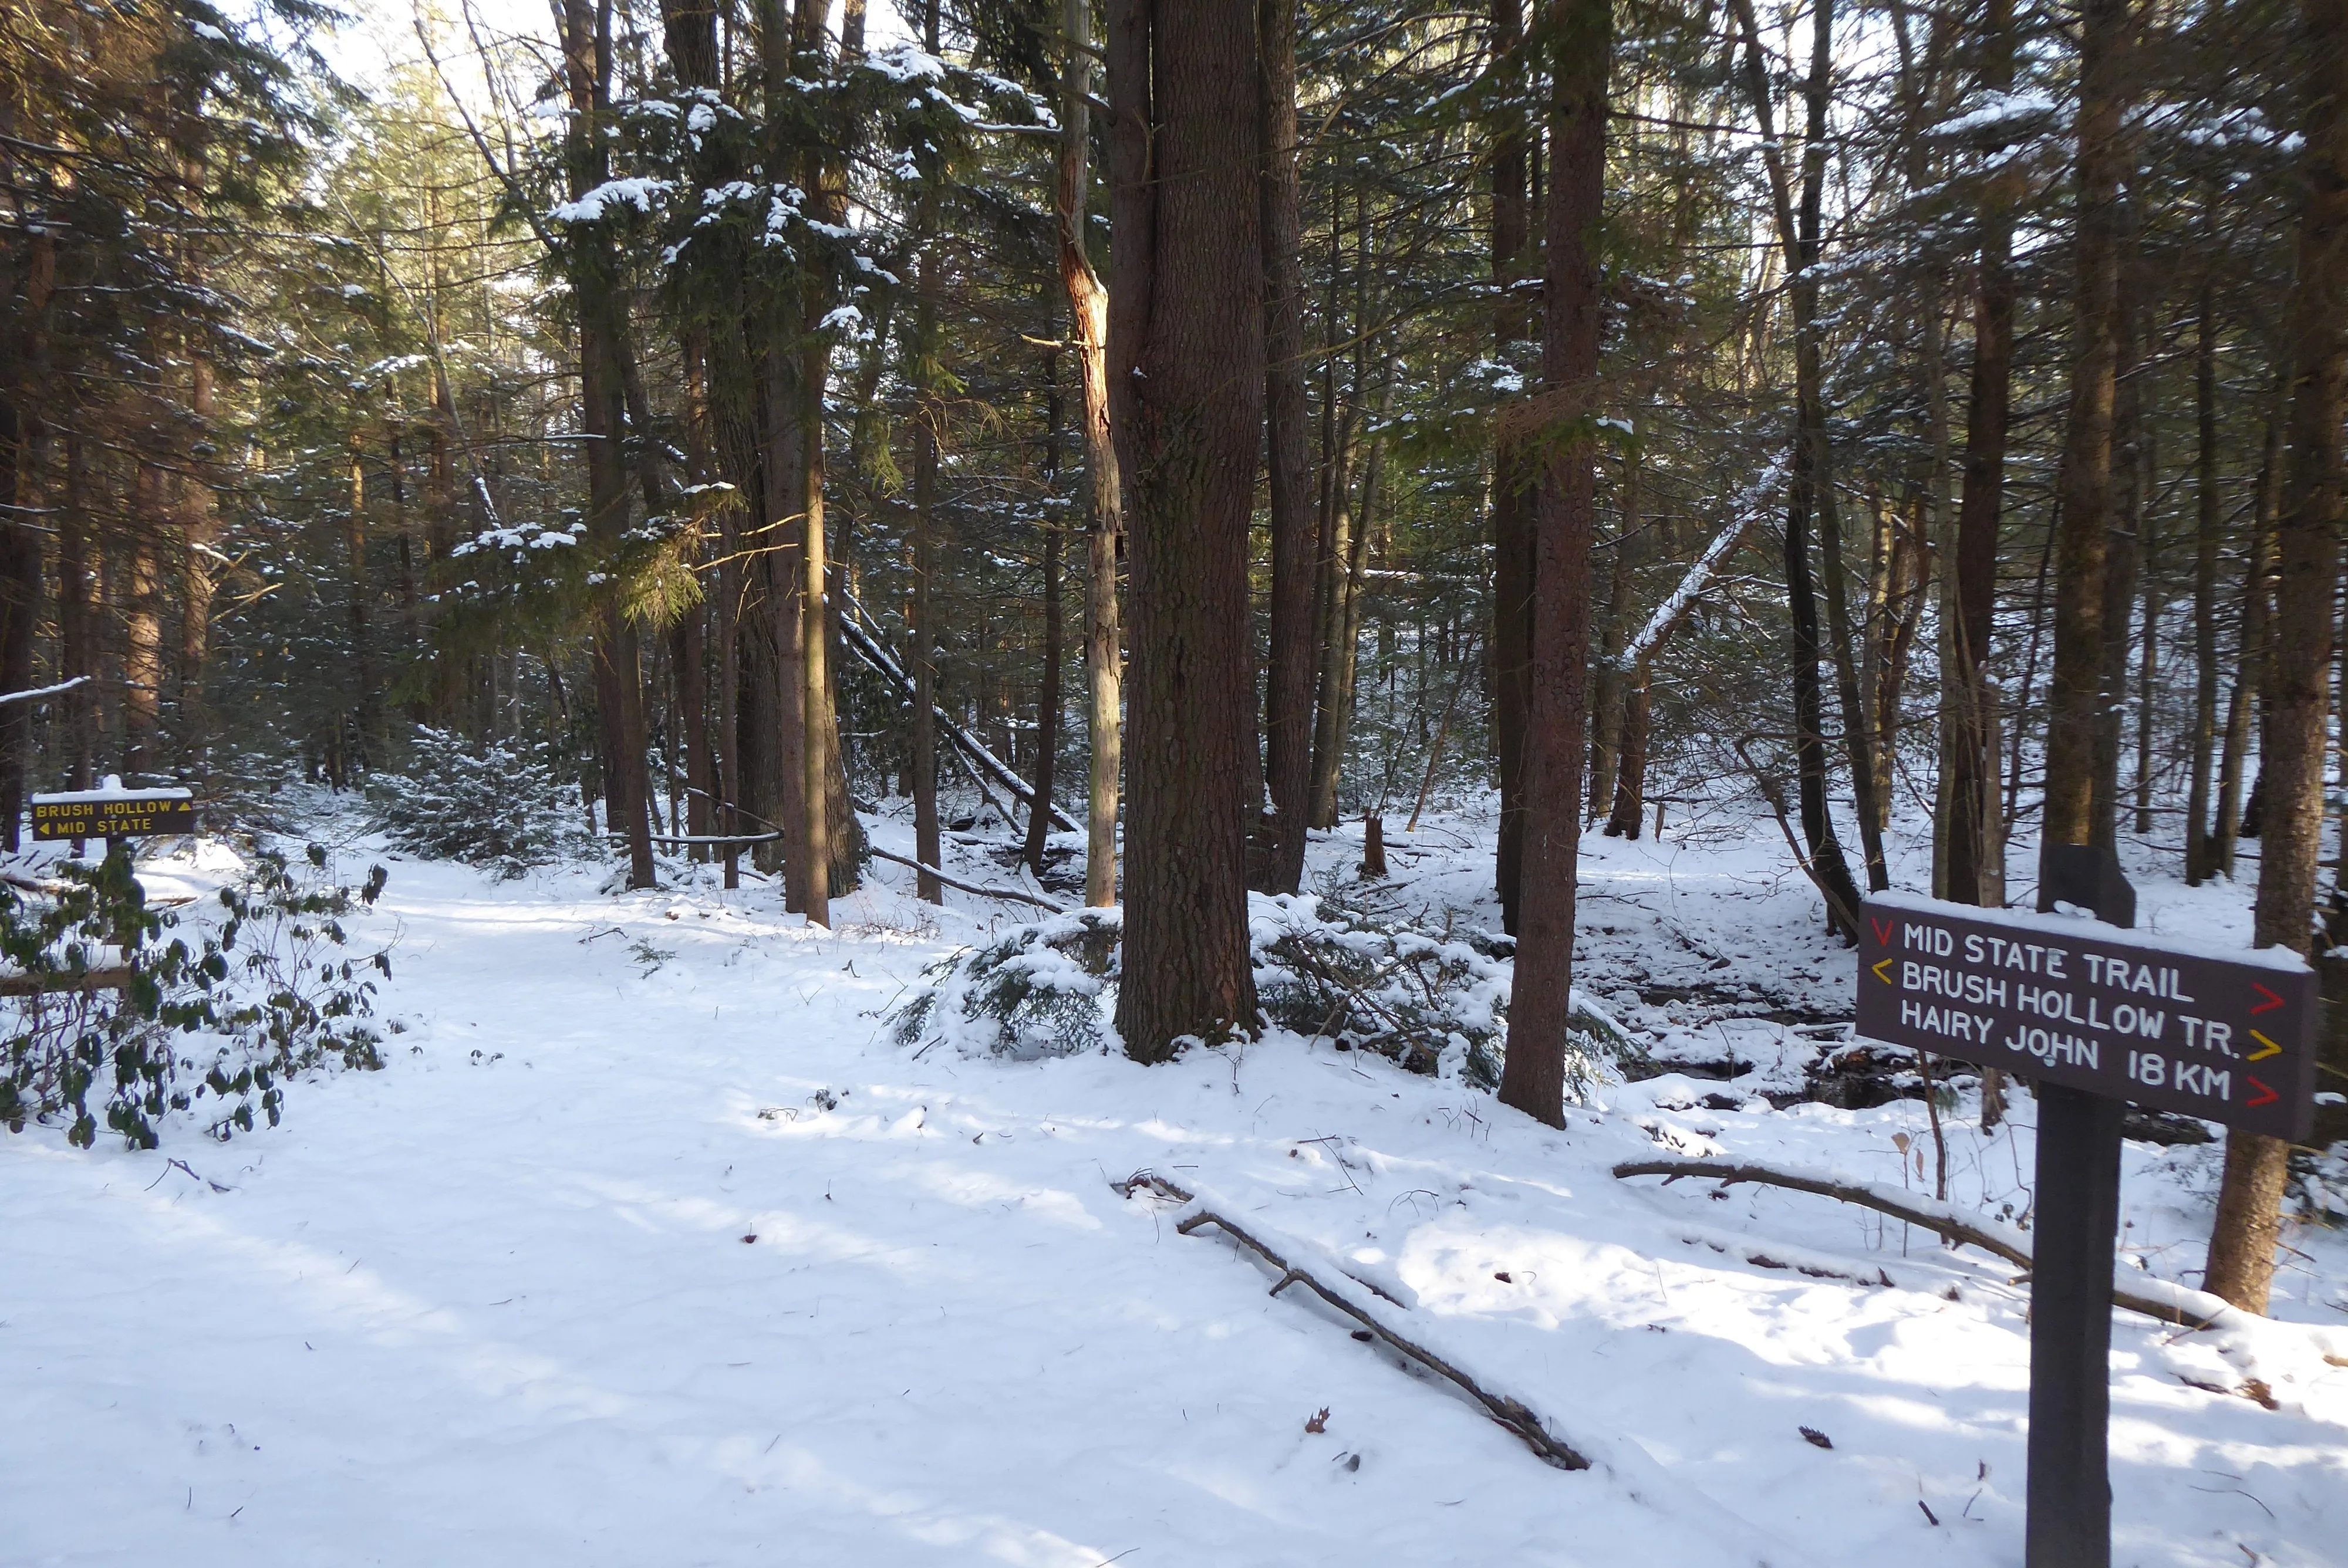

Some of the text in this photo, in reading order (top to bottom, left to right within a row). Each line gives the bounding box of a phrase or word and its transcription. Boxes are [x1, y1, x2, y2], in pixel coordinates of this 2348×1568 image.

[36, 801, 171, 817] BRUSH HOLLOW
[57, 818, 151, 834] MID STATE
[1904, 922, 2195, 1003] MID STATE TRAIL
[1901, 999, 2230, 1101] HAIRY JOHN 18 KM
[1902, 960, 2241, 1059] BRUSH HOLLOW TR.
